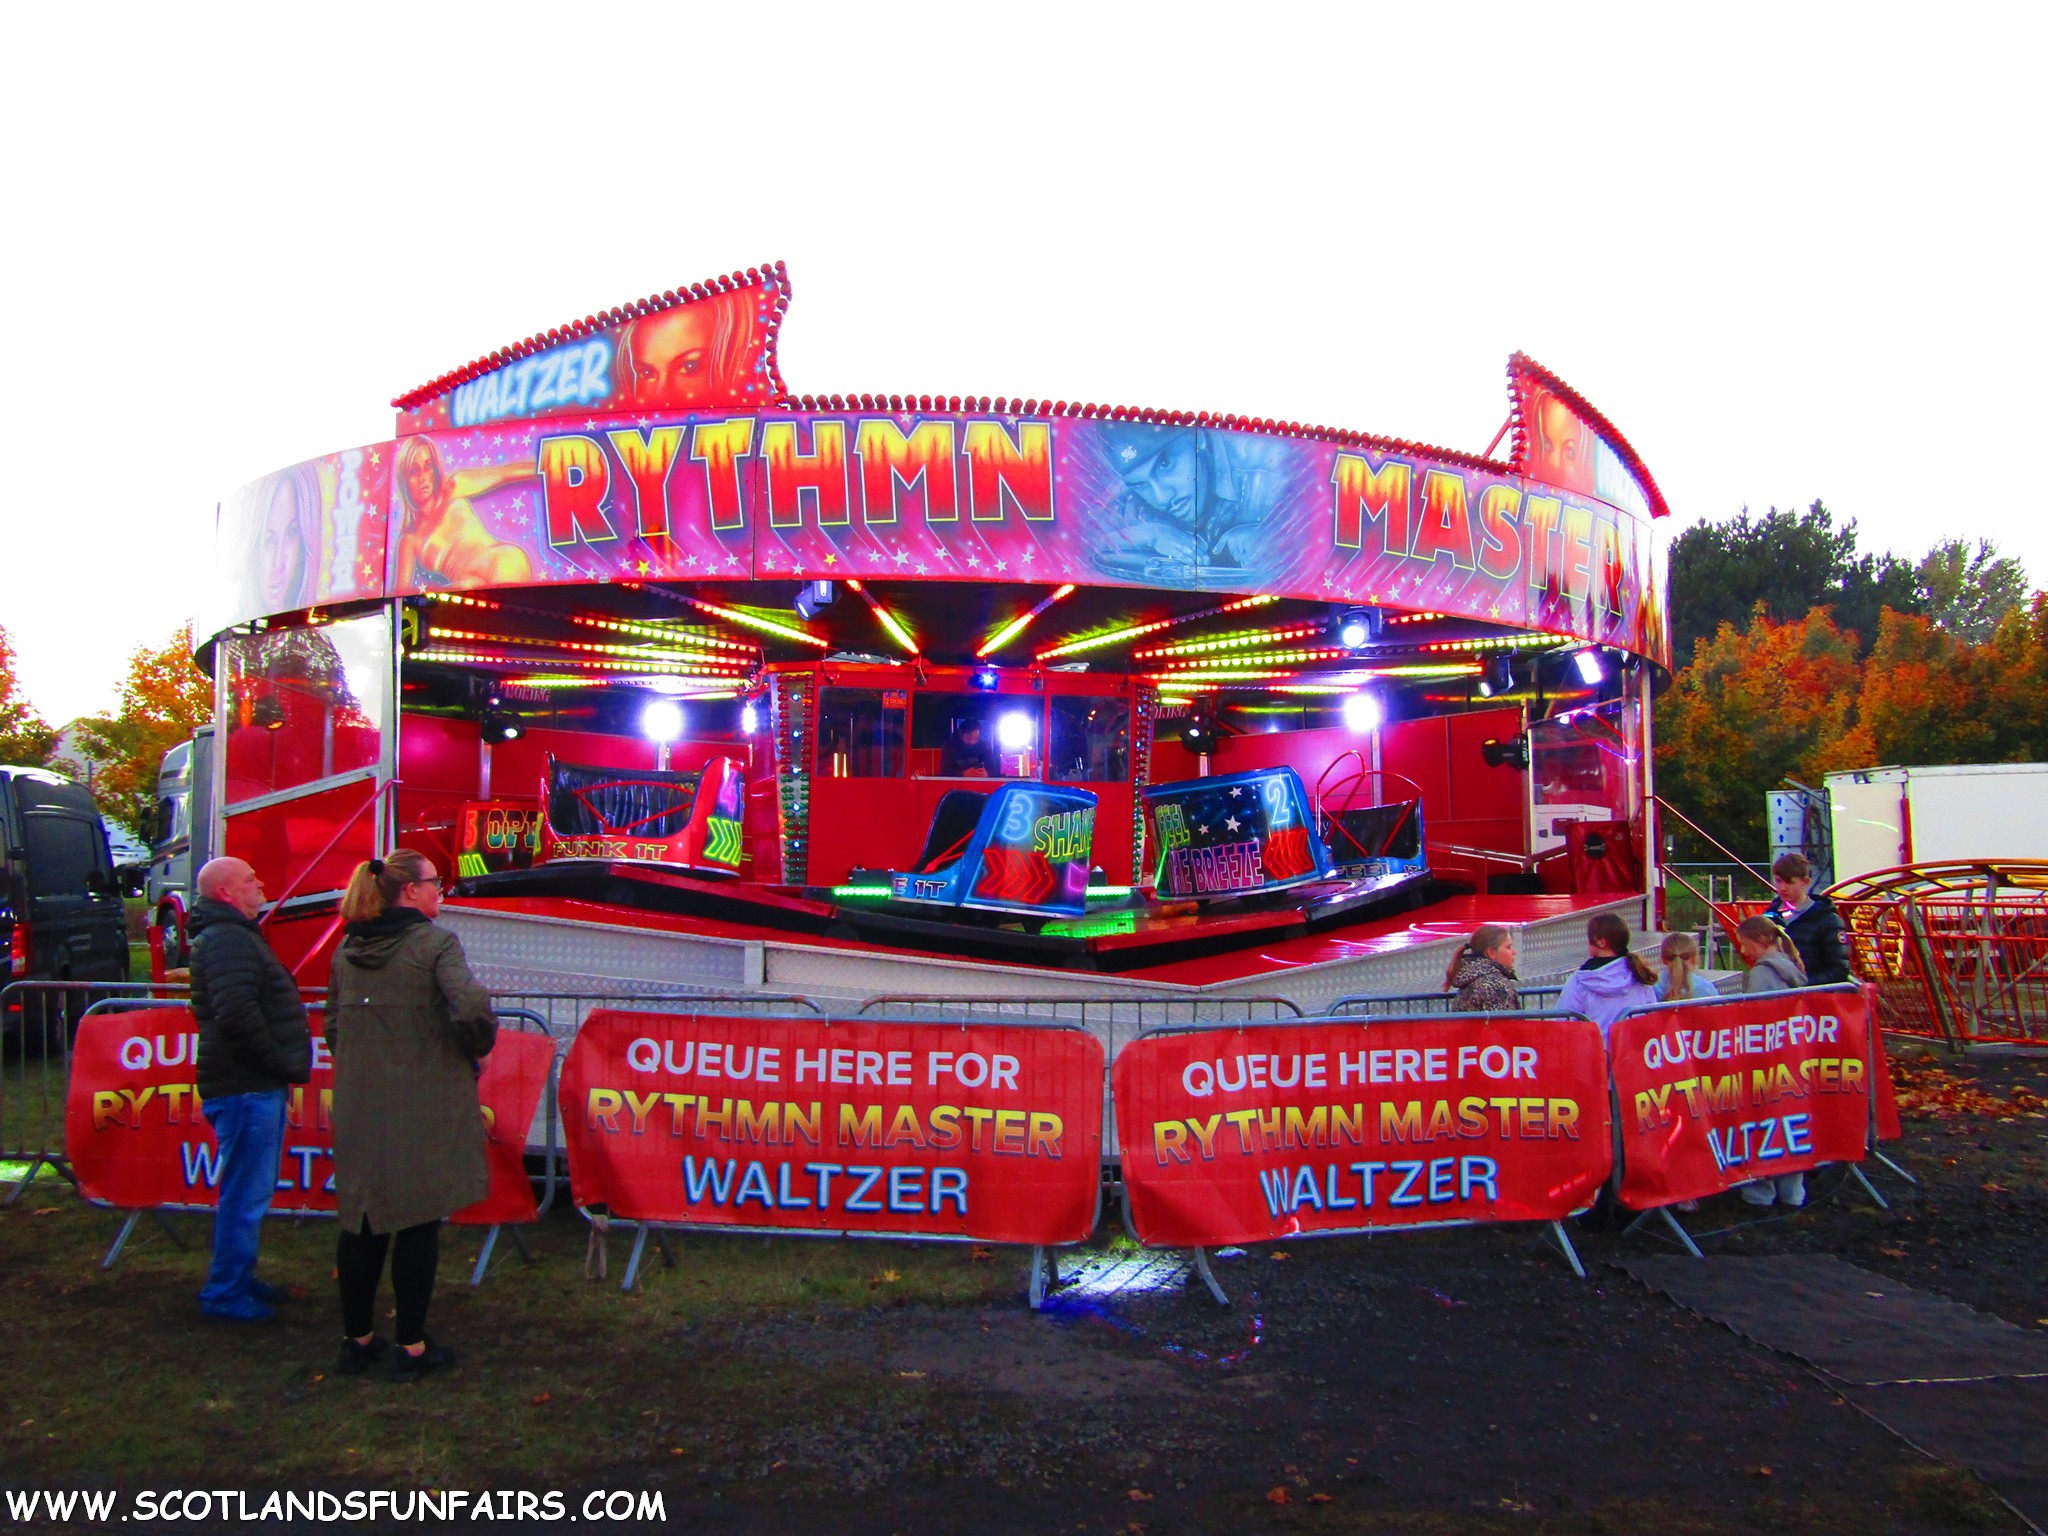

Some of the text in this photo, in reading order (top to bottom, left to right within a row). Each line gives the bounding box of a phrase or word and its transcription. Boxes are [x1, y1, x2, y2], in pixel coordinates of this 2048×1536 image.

[453, 342, 608, 427] WALTZER
[537, 417, 1054, 548] RYTHMN
[1330, 453, 1622, 617] MASTER
[1001, 792, 1034, 841] 3
[1266, 778, 1290, 825] 2
[553, 841, 668, 861] FUNK IT
[1191, 840, 1264, 893] BREEZE
[915, 880, 947, 898] IT
[1734, 1020, 1788, 1057] HERE
[1787, 1015, 1838, 1046] FOR
[627, 1037, 1020, 1090] QUEUE HERE FOR
[1182, 1045, 1538, 1097] QUEUE HERE FOR
[587, 1087, 1064, 1159] RYTHMN MASTER
[1153, 1096, 1580, 1166] RYTHMN MASTER
[682, 1154, 969, 1216] WALTZER
[1259, 1155, 1499, 1218] WALTZER
